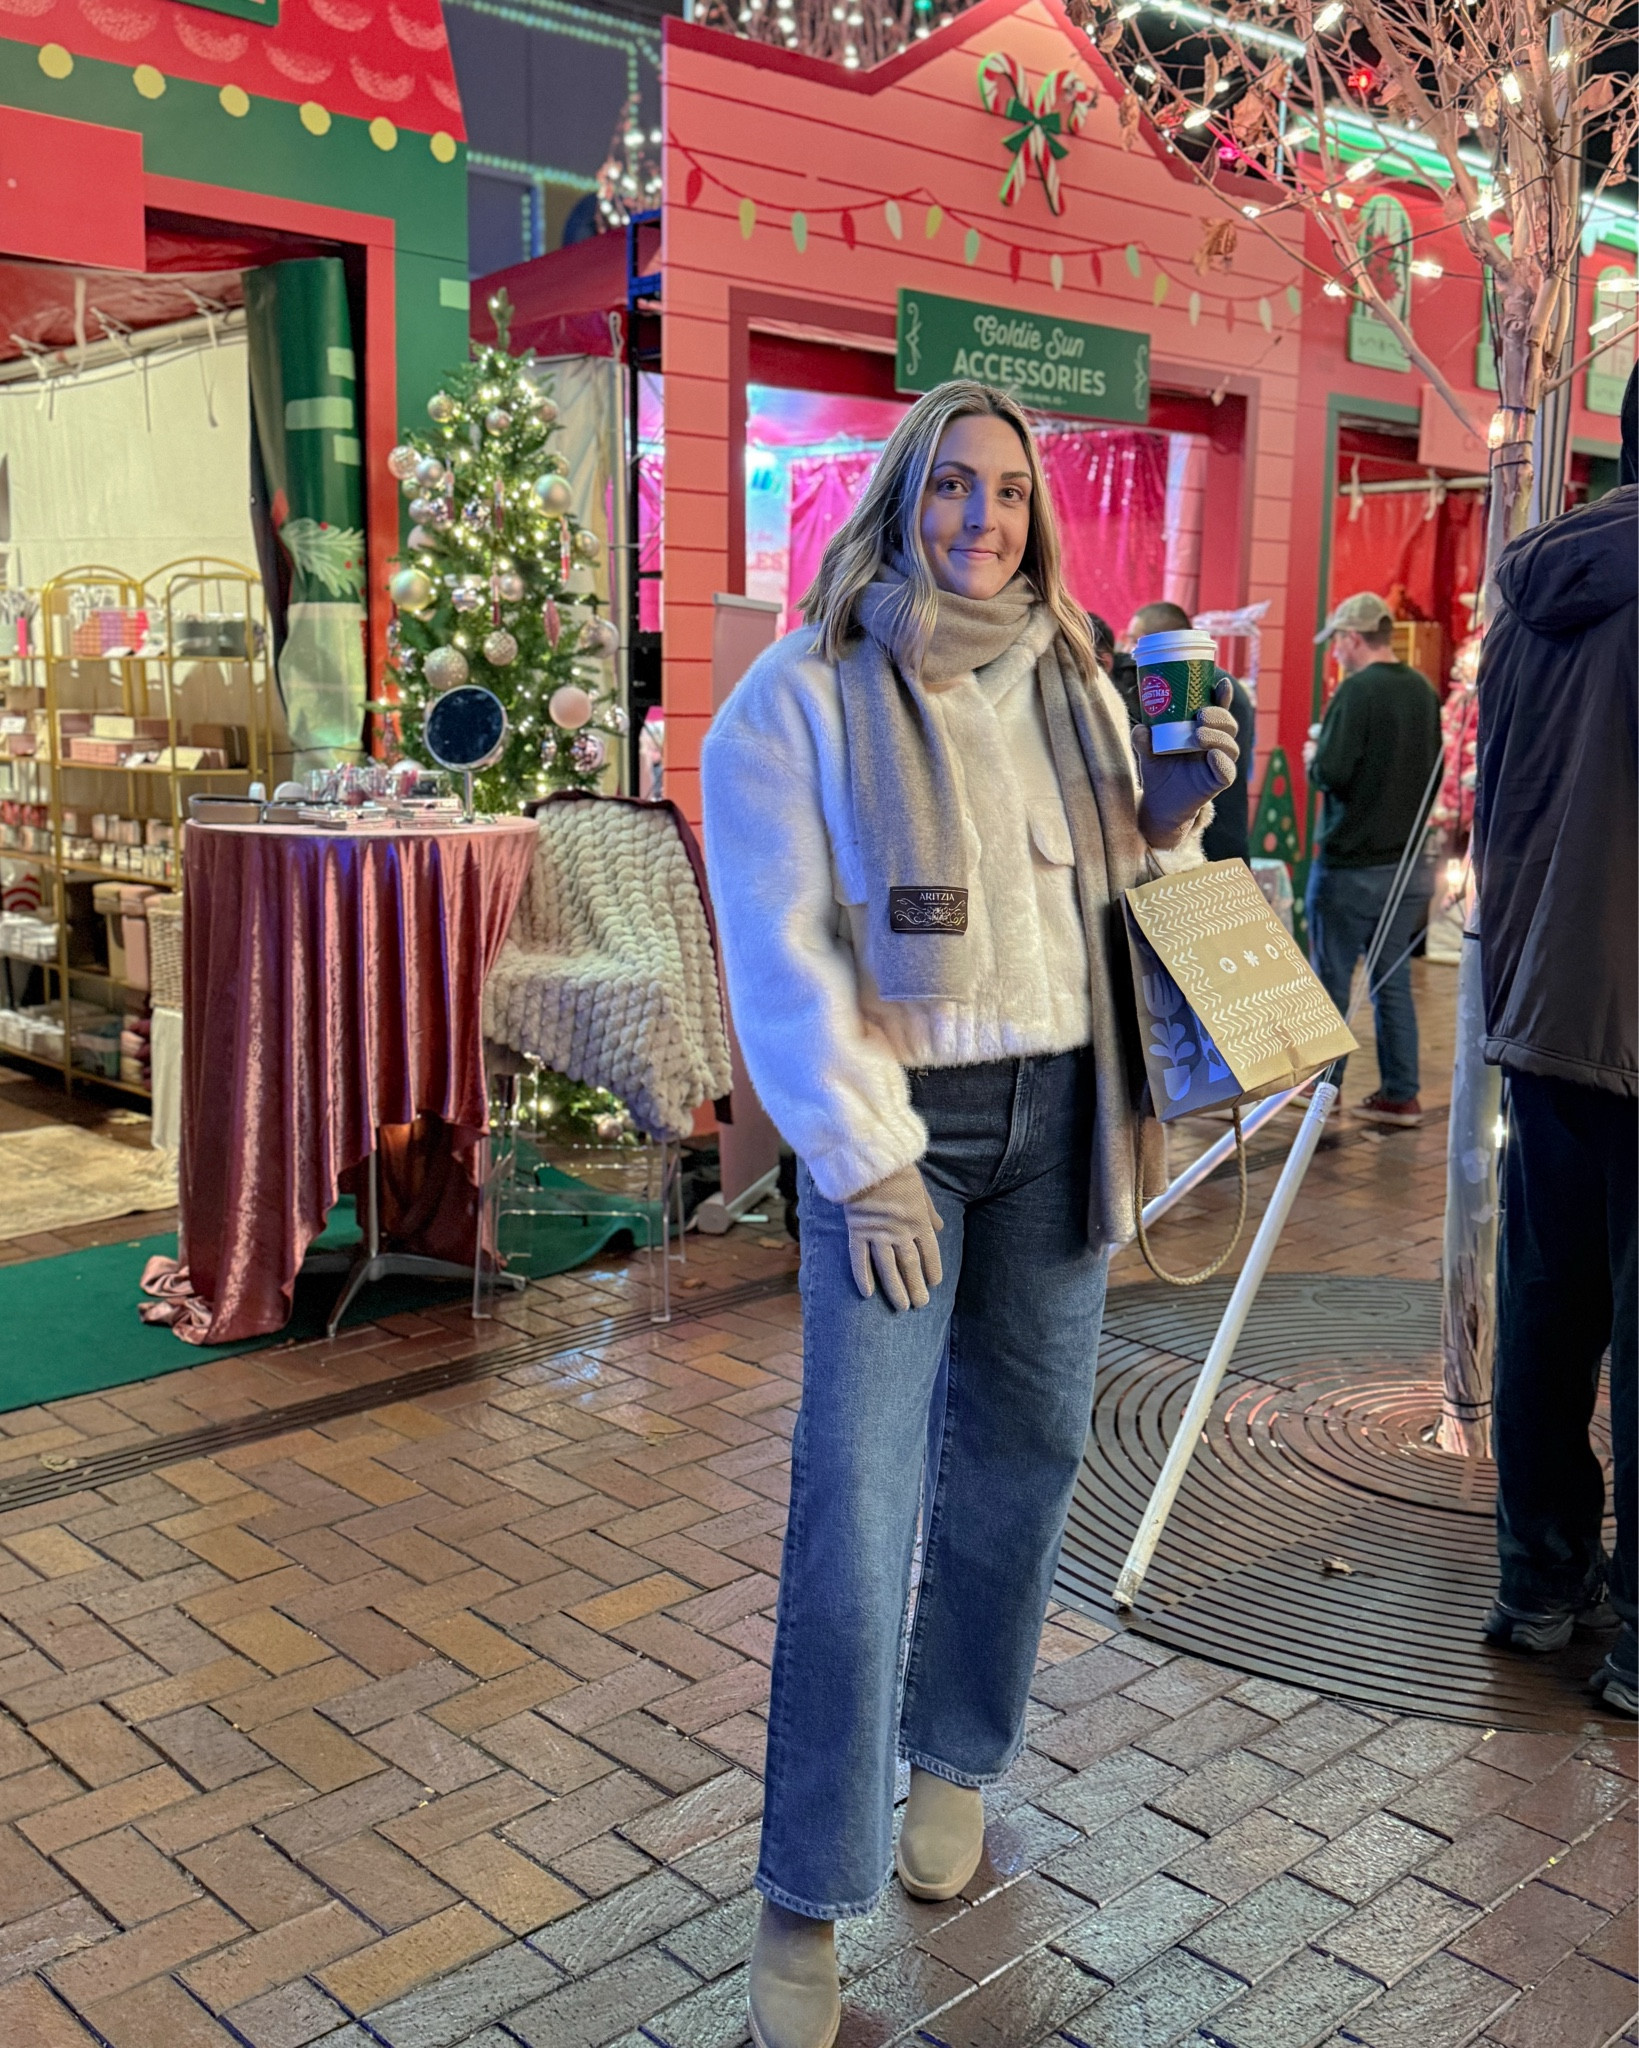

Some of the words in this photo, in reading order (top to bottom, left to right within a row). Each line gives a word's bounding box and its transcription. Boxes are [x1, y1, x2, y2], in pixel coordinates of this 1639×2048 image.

[973, 314, 1042, 351] Goldie
[1045, 327, 1086, 361] Sun
[952, 348, 1107, 397] ACCESSORIES
[919, 892, 955, 902] ARITZIA
